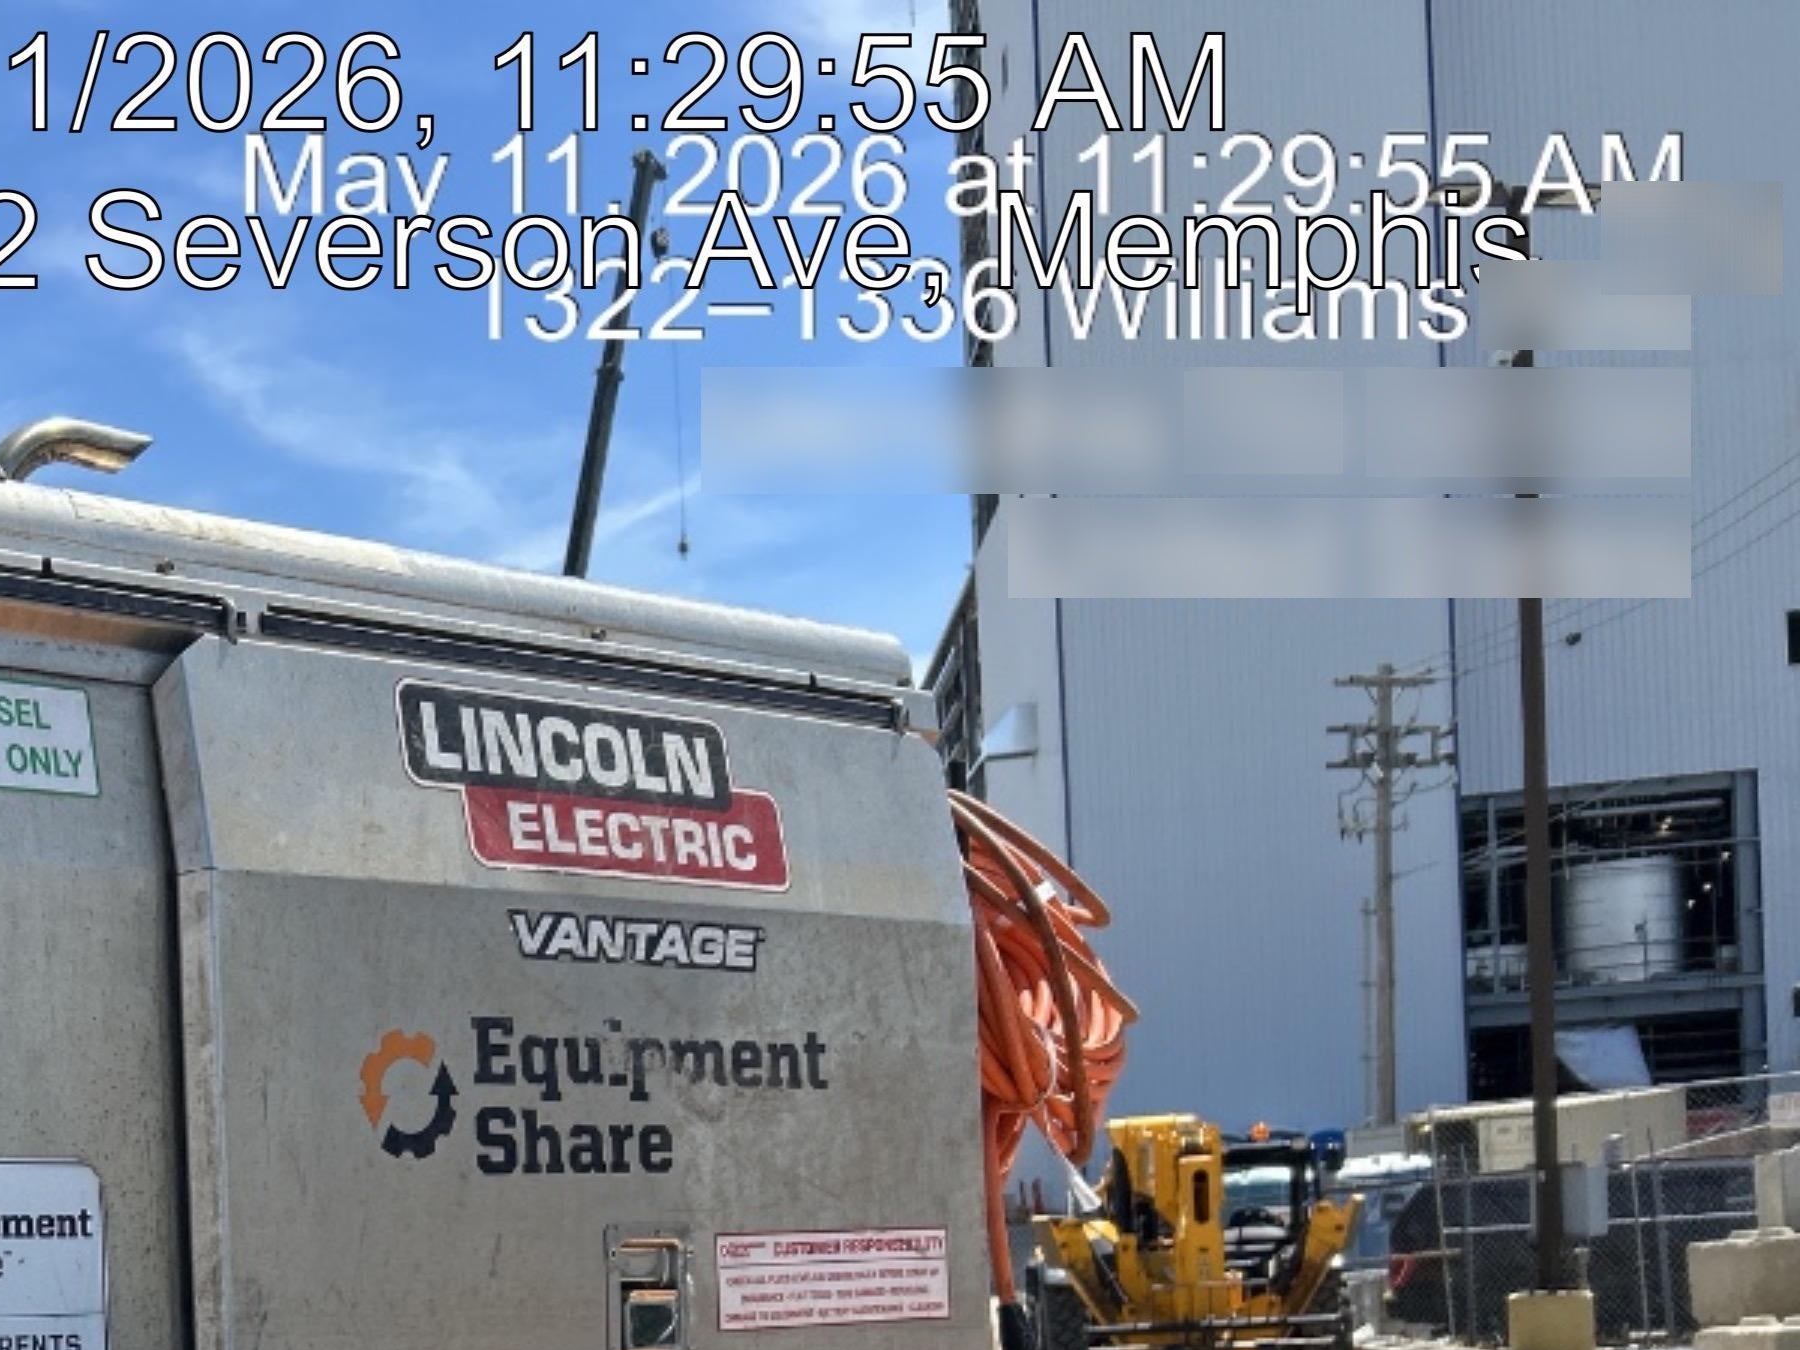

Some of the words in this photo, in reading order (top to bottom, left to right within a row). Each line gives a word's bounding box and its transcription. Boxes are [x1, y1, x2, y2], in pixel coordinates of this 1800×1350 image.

[6, 743, 84, 779] ONLY
[418, 701, 716, 800] LINCOLN
[506, 802, 758, 871] ELECTRIC
[511, 911, 760, 969] VANTAGE
[472, 1016, 828, 1101] Equipment
[473, 1106, 673, 1175] Share
